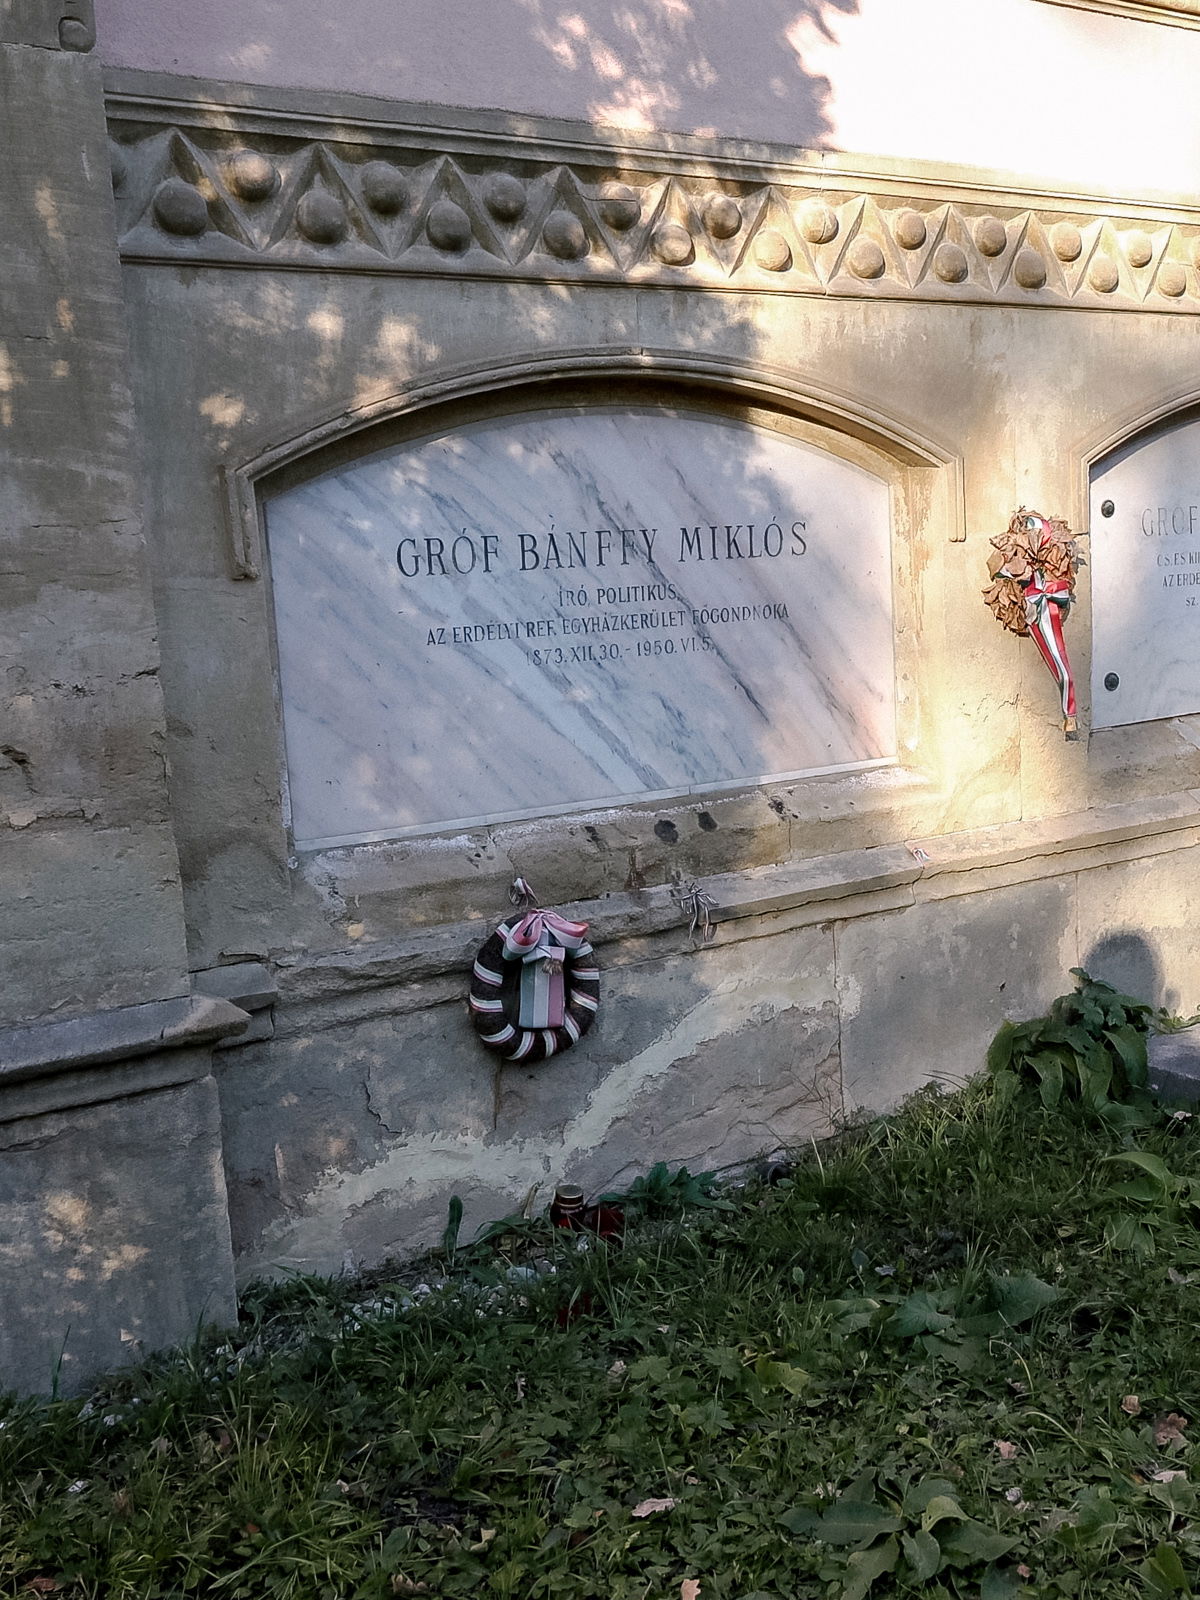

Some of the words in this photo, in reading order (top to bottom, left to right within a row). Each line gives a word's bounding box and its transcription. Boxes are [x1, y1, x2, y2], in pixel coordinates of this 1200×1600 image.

[396, 527, 500, 577] GRÓF
[518, 524, 658, 572] BÁNFFY
[678, 516, 807, 562] MIKLÓS
[1162, 574, 1174, 588] AZ
[426, 628, 447, 646] AZ
[453, 620, 520, 643] ERDÉLYI
[562, 609, 686, 635] EGYHÁZKERÜLET
